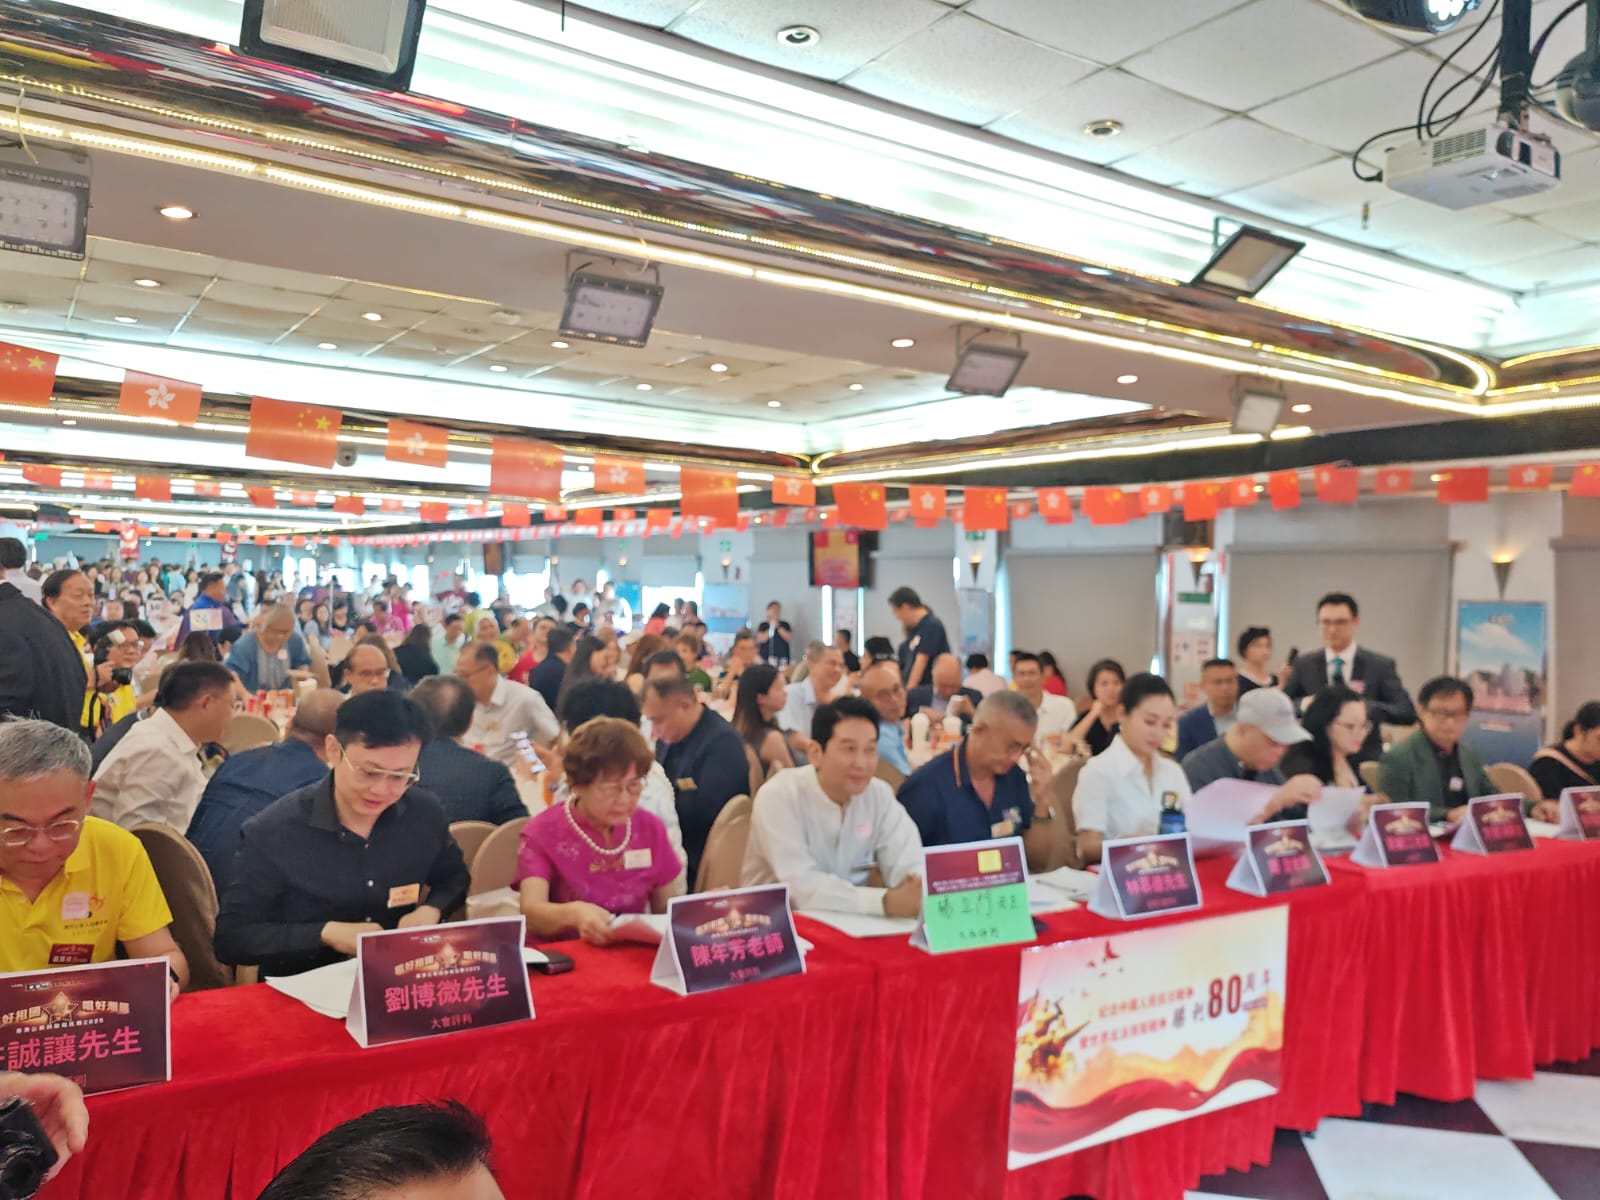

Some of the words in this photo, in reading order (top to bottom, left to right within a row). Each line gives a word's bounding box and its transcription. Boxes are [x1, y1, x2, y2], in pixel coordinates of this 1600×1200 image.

[690, 932, 784, 968] 陳年芳老師
[384, 972, 510, 1013] 劉博微先生
[1209, 974, 1242, 1018] 80
[431, 1013, 473, 1030] 大會評判
[0, 1026, 142, 1071] 誠讓先生
